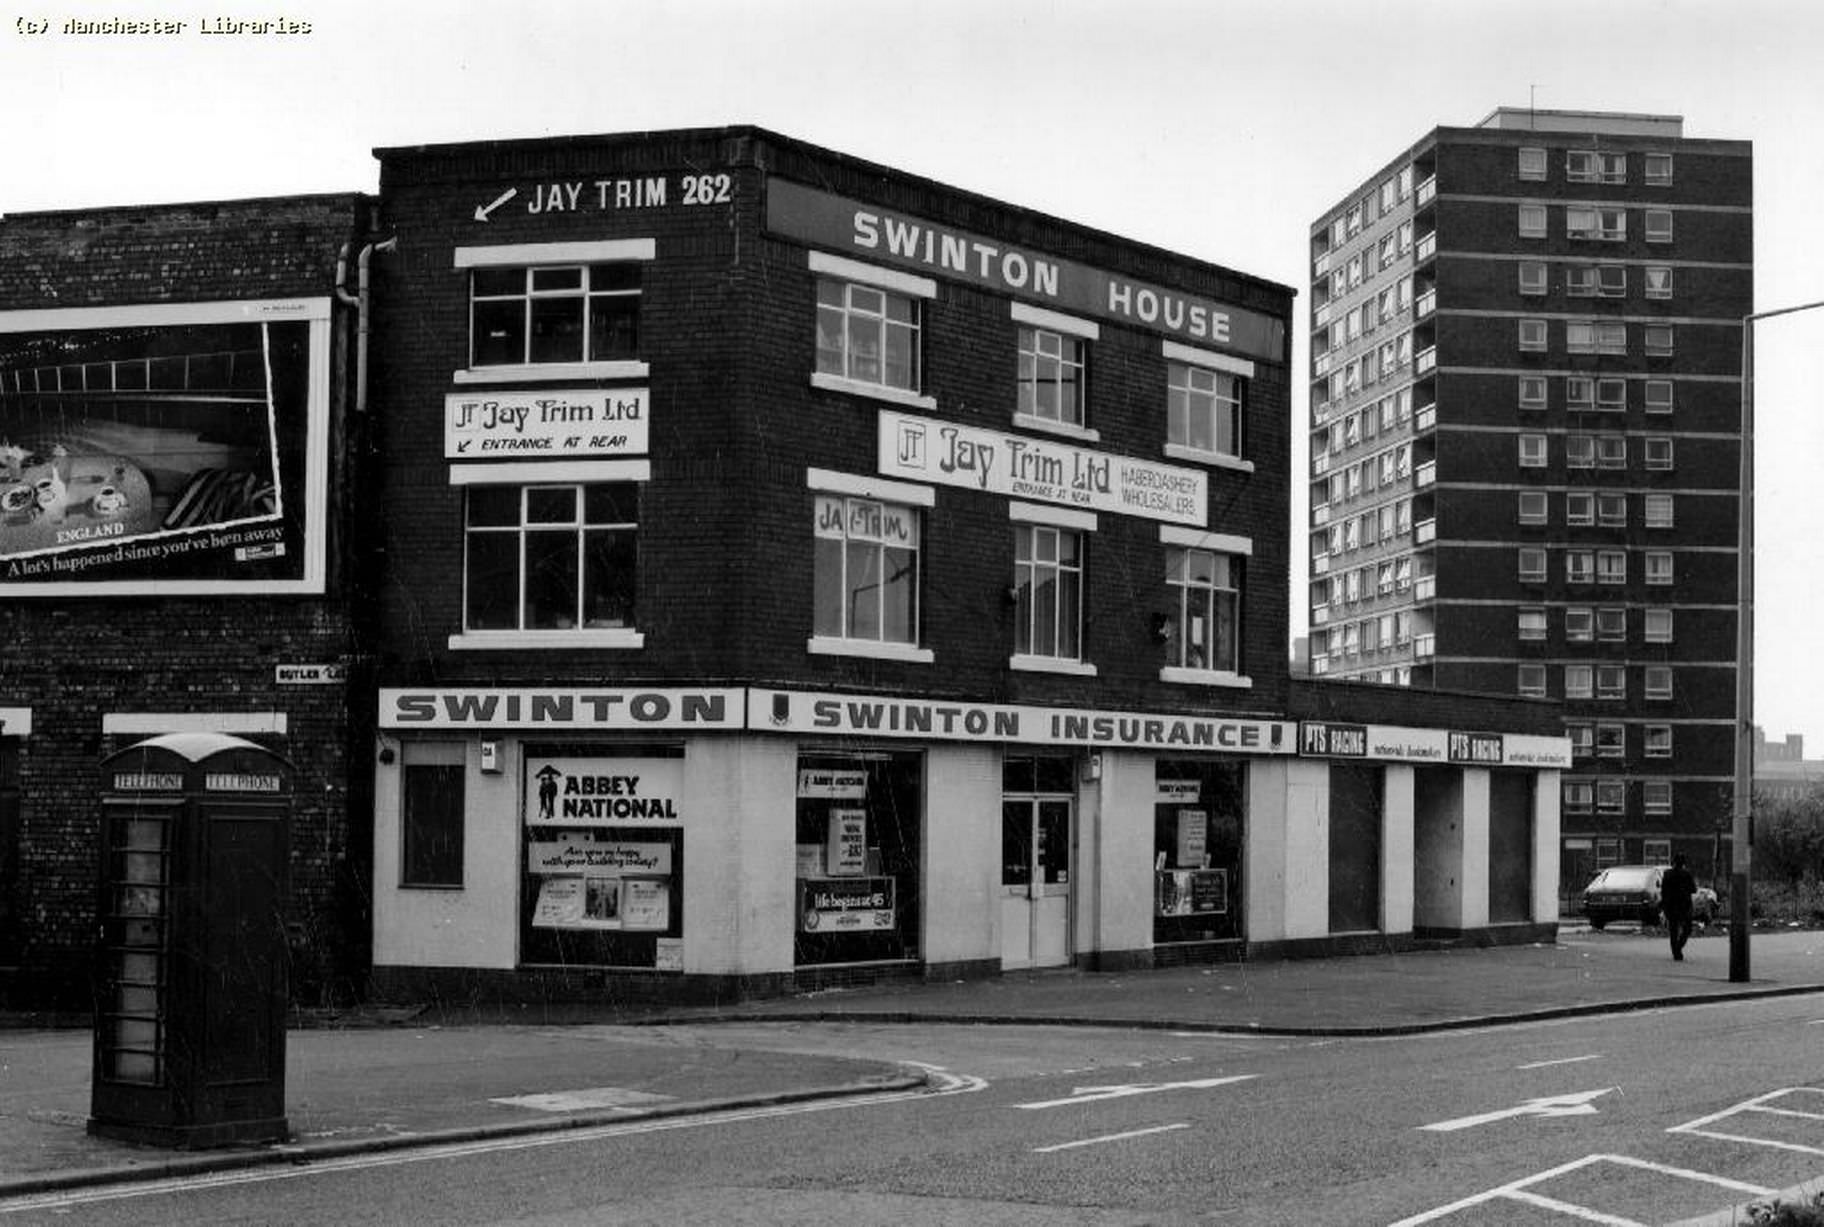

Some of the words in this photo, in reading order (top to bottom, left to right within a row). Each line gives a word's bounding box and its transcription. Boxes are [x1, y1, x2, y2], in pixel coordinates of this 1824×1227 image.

[528, 182, 583, 214] JAY
[595, 177, 666, 209] TRIM
[682, 173, 731, 205] 262
[854, 210, 1059, 297] SWINTON
[1108, 281, 1230, 344] HOUSE
[483, 401, 530, 433] Jay
[535, 400, 594, 423] Trim
[602, 397, 642, 421] Ltd
[481, 436, 554, 451] ENTRANCE
[563, 436, 582, 449] AT
[588, 435, 628, 448] REAR
[939, 427, 994, 488] Jay
[1005, 439, 1062, 487] Trim
[1072, 452, 1112, 494] Ltd
[56, 522, 124, 544] ENGLAND
[8, 562, 20, 577] A
[22, 560, 50, 575] lot's
[53, 546, 123, 573] happened
[125, 543, 161, 561] since
[162, 538, 209, 558] you've
[211, 533, 242, 548] been
[244, 527, 285, 542] away
[396, 693, 727, 722] SWINTON
[813, 700, 1020, 736] SWINTON
[1050, 714, 1261, 748] INSURANCE
[1305, 724, 1327, 753] PTS
[1450, 732, 1469, 760] PTS
[115, 774, 182, 789] TELEPHONE
[207, 775, 279, 790] TELEPHONE
[564, 776, 640, 796] ABBEY
[562, 798, 677, 819] NATIONAL
